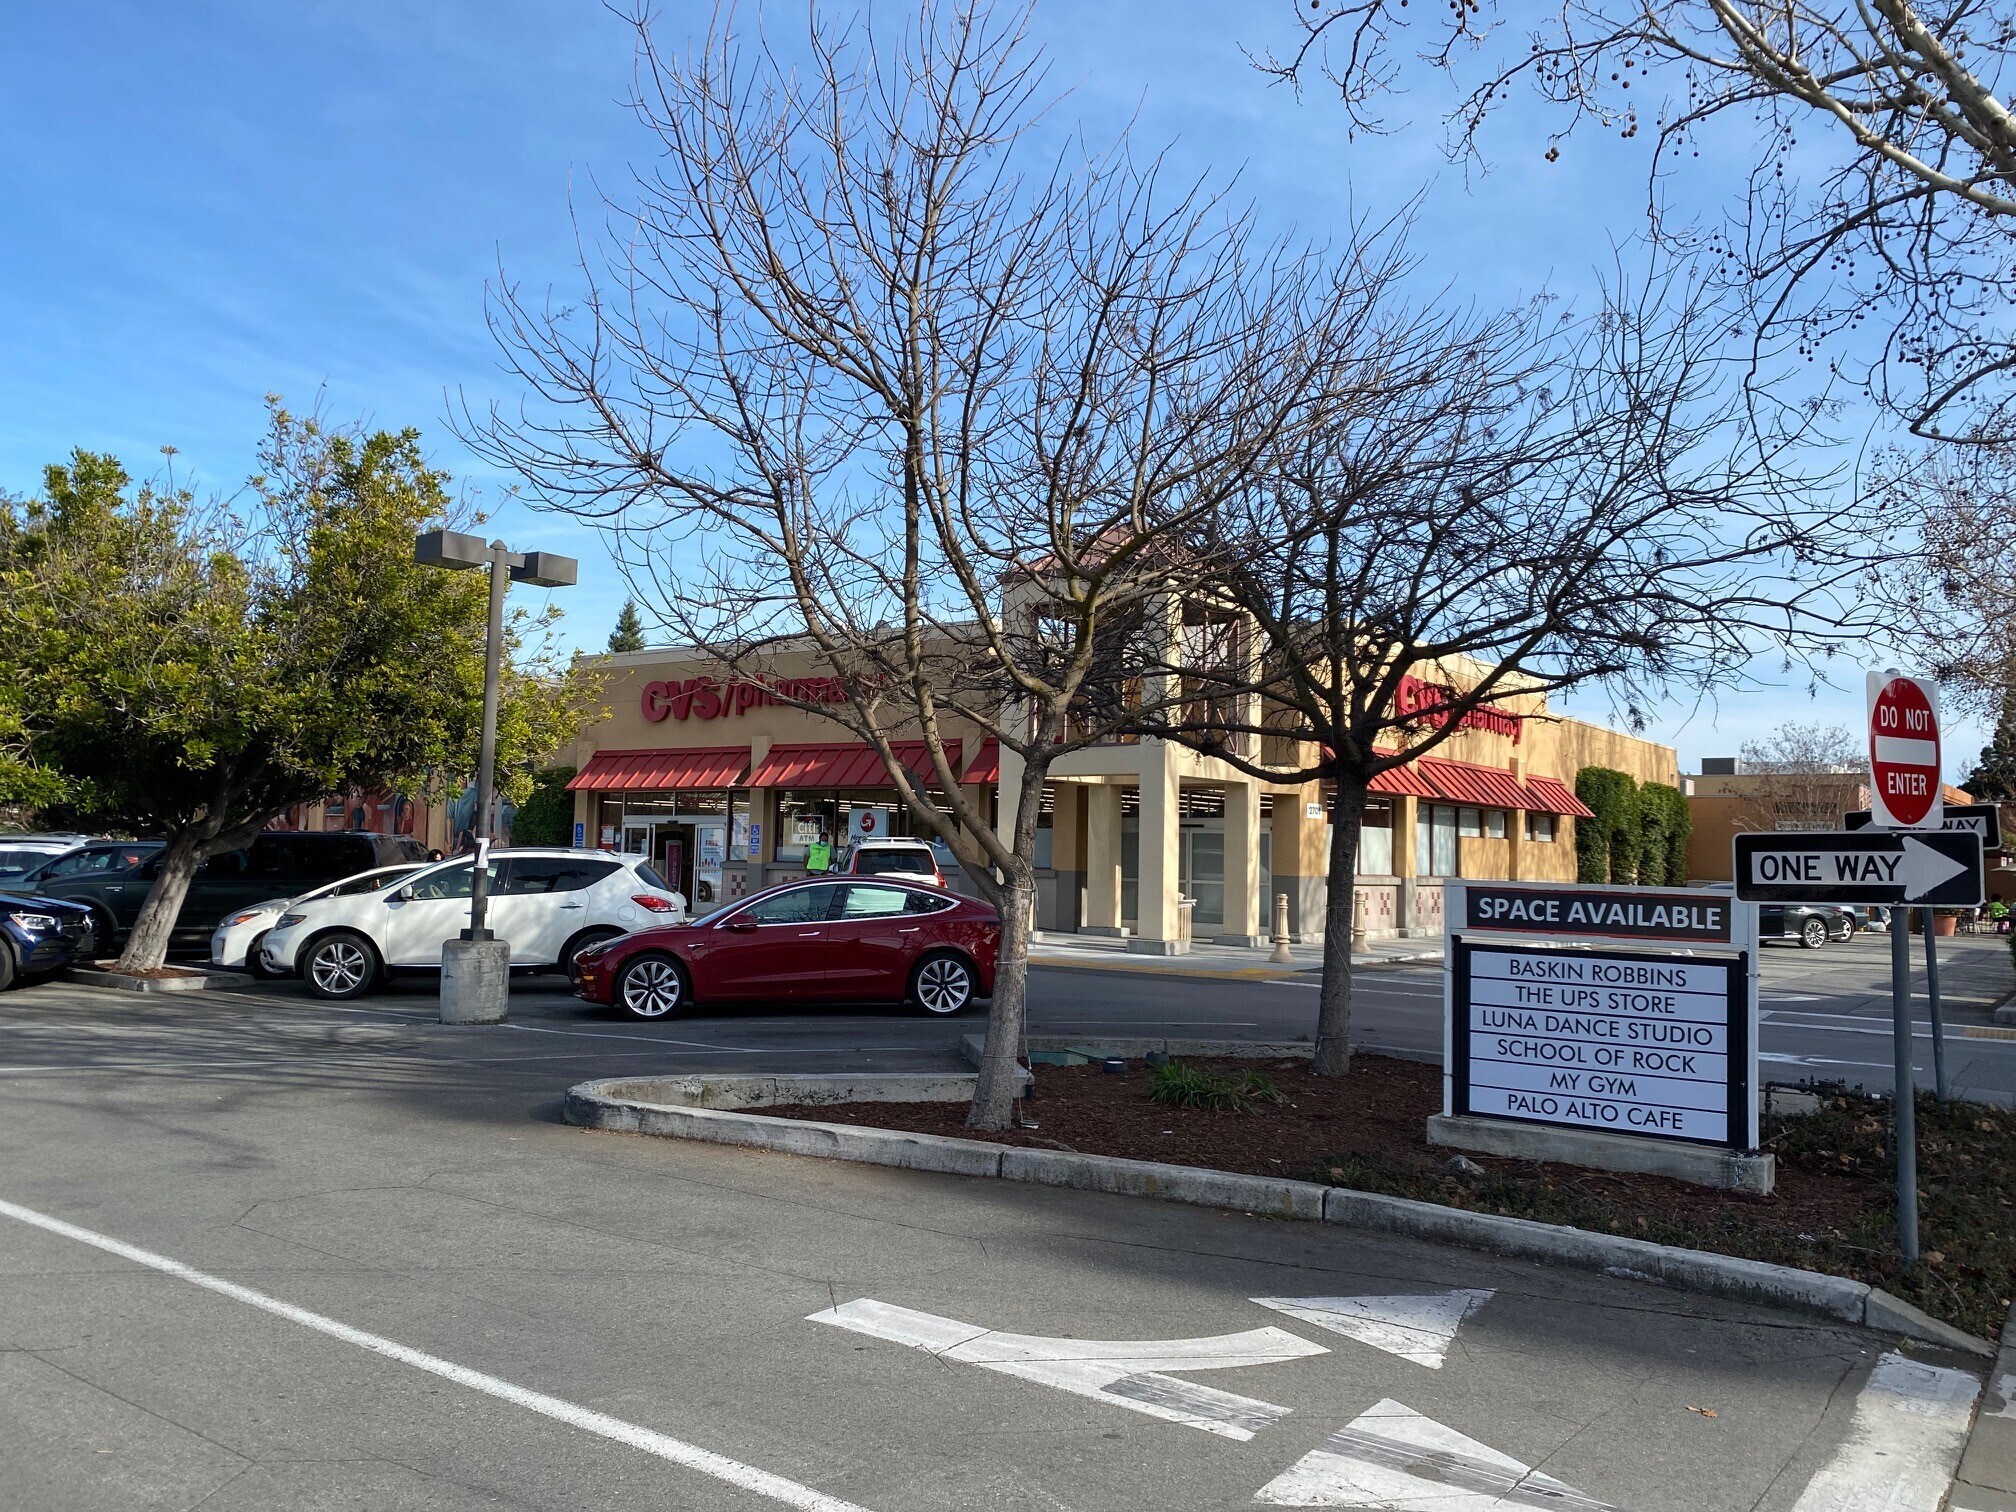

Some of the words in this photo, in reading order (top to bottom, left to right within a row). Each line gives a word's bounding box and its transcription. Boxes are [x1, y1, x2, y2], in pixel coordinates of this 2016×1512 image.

[641, 674, 885, 722] CVS/pharma
[1395, 674, 1522, 747] CVSharmacy
[1880, 705, 1898, 728] DO
[1905, 708, 1930, 731] NOT
[1887, 772, 1927, 796] ENTER
[799, 834, 815, 842] ATM
[1760, 855, 1822, 881] ONE
[1834, 855, 1903, 881] WAY
[1478, 897, 1560, 922] SPACE
[1567, 901, 1722, 930] AVAILABLE
[1509, 958, 1584, 980] BASKIN
[1592, 964, 1687, 987] ROBBINS
[1515, 985, 1553, 1004] THE
[1561, 989, 1600, 1008] UPS
[1608, 992, 1676, 1014] STORE
[1482, 1010, 1538, 1031] LUNA
[1545, 1015, 1620, 1038] DANCE
[1627, 1021, 1713, 1046] STUDIO
[1497, 1039, 1587, 1063] SCHOOL
[1594, 1048, 1625, 1066] OF
[1633, 1051, 1697, 1074] ROCK
[1550, 1072, 1581, 1090] MY
[1588, 1075, 1637, 1097] GYM
[1507, 1094, 1559, 1115] PALO
[1565, 1101, 1619, 1122] ALTO
[1627, 1107, 1683, 1130] CAFE
